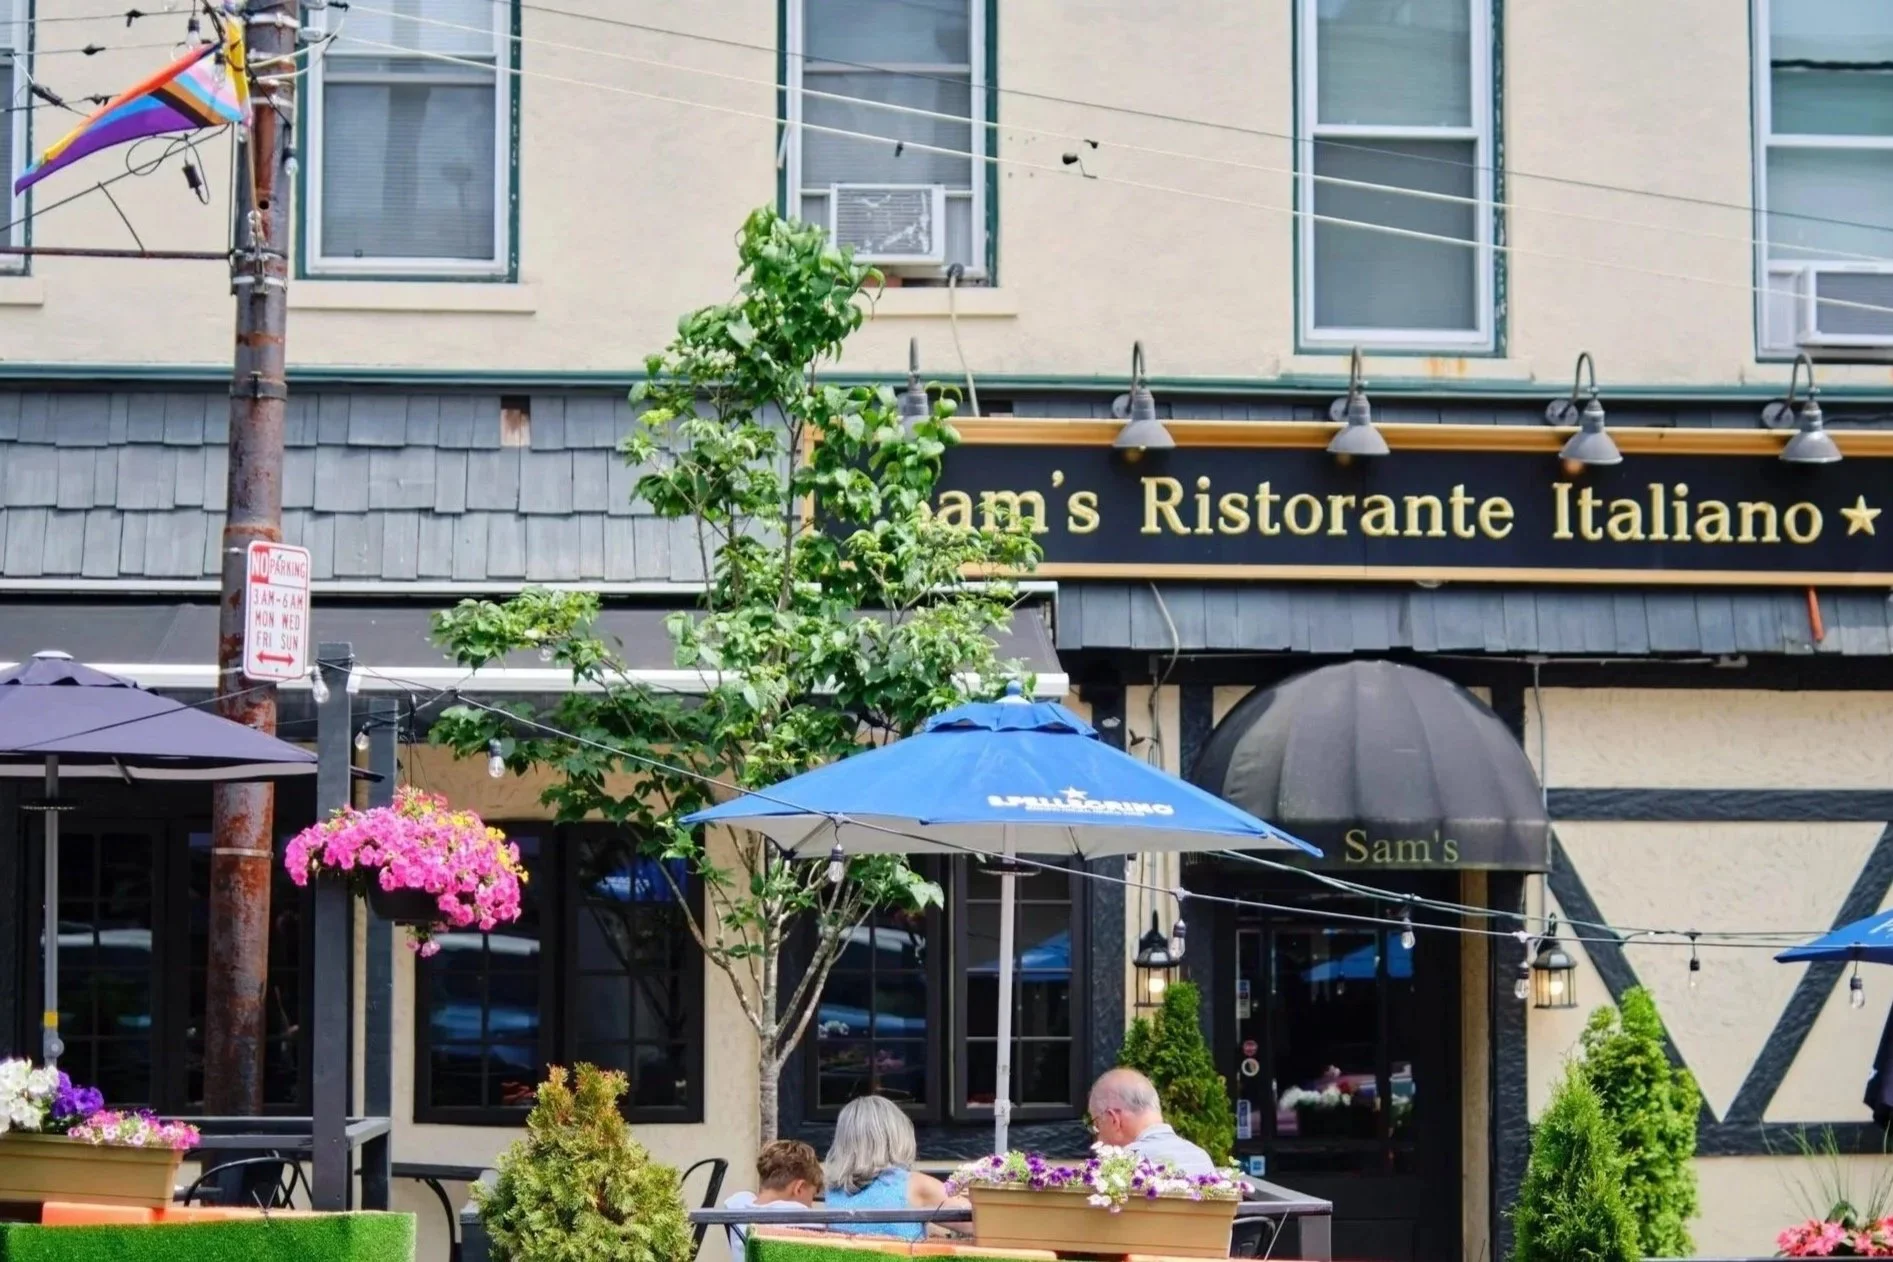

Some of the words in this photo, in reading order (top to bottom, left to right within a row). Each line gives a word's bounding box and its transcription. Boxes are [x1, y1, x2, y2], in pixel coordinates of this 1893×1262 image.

[916, 469, 1100, 534] am's
[1140, 475, 1515, 538] Ristorante
[1551, 482, 1824, 544] Italiano
[251, 551, 268, 577] NO
[269, 558, 305, 579] PARKING
[255, 610, 274, 628] MON
[282, 613, 300, 631] WED
[256, 631, 272, 648] FRI
[280, 633, 298, 651] SUN
[1344, 828, 1460, 864] Sam's
